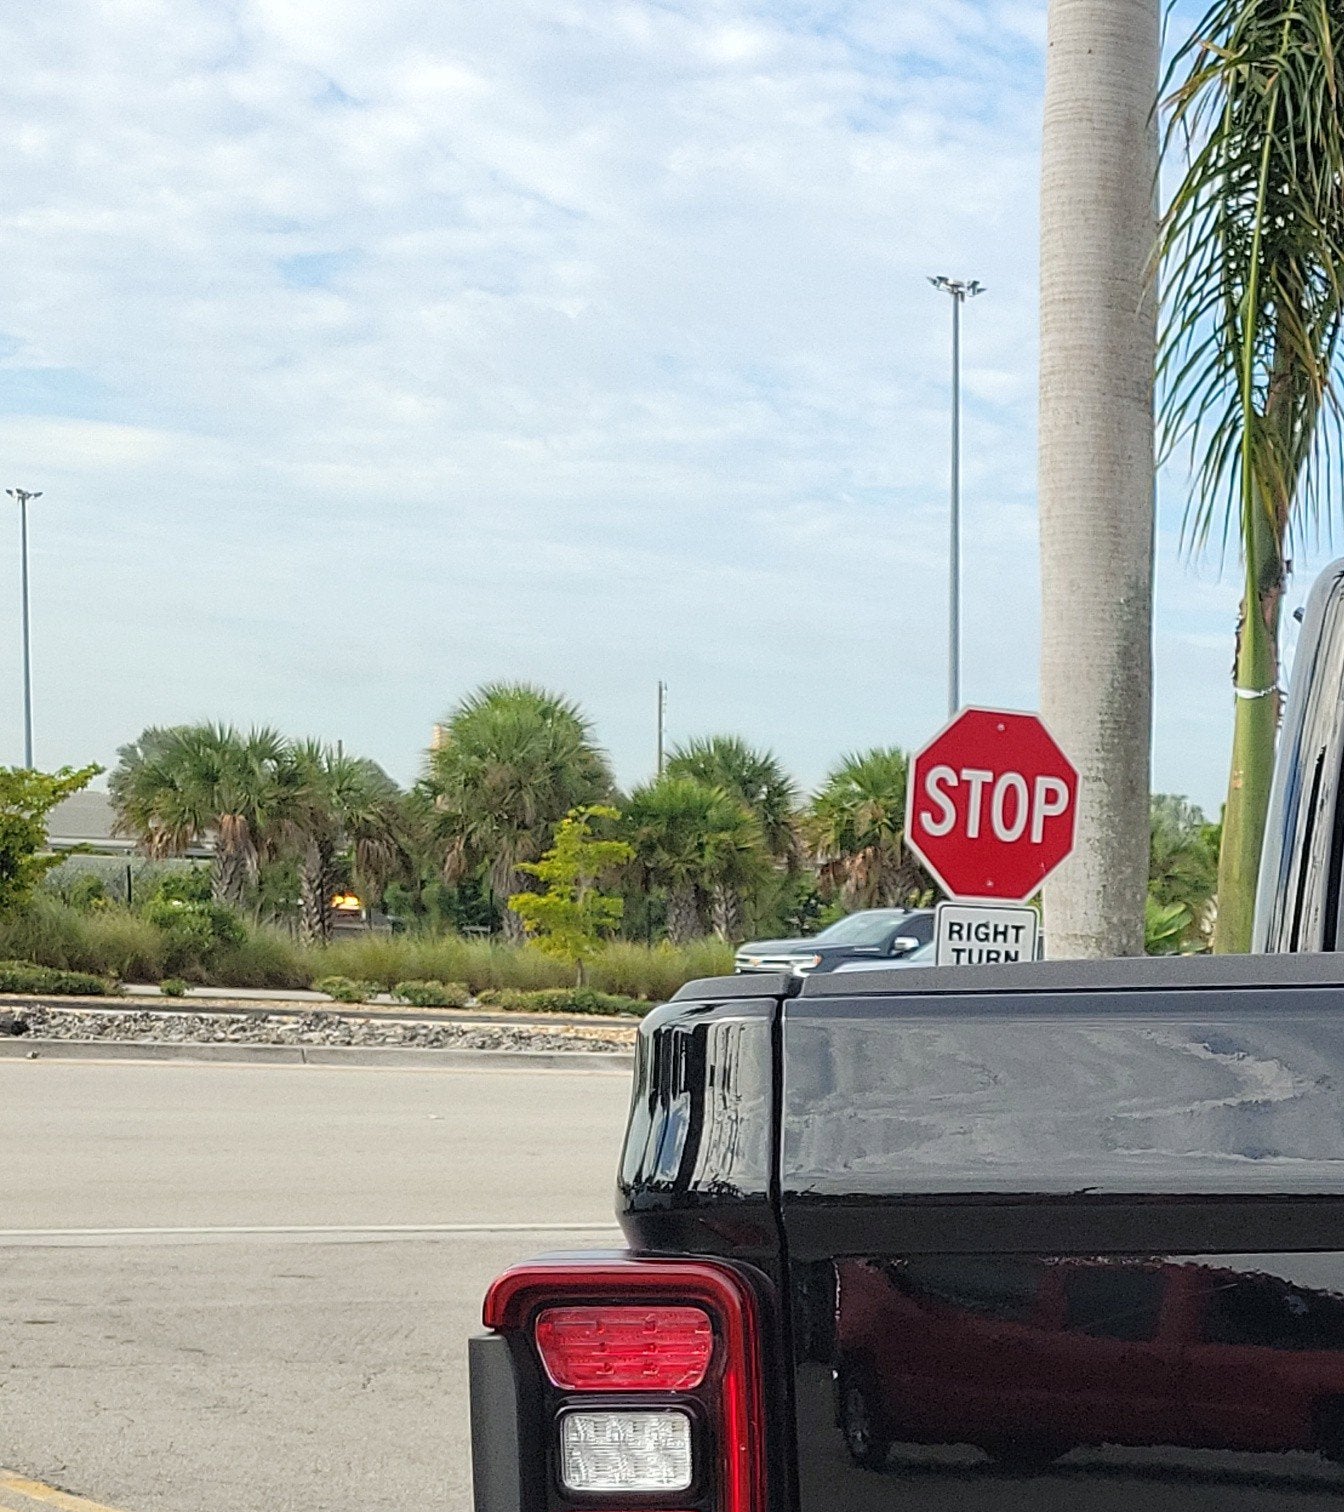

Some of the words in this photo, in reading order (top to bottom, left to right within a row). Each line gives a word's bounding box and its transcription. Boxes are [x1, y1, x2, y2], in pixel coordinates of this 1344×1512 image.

[919, 765, 1069, 844] STOP
[948, 921, 1026, 944] RIGHT
[951, 948, 1019, 965] TURN
